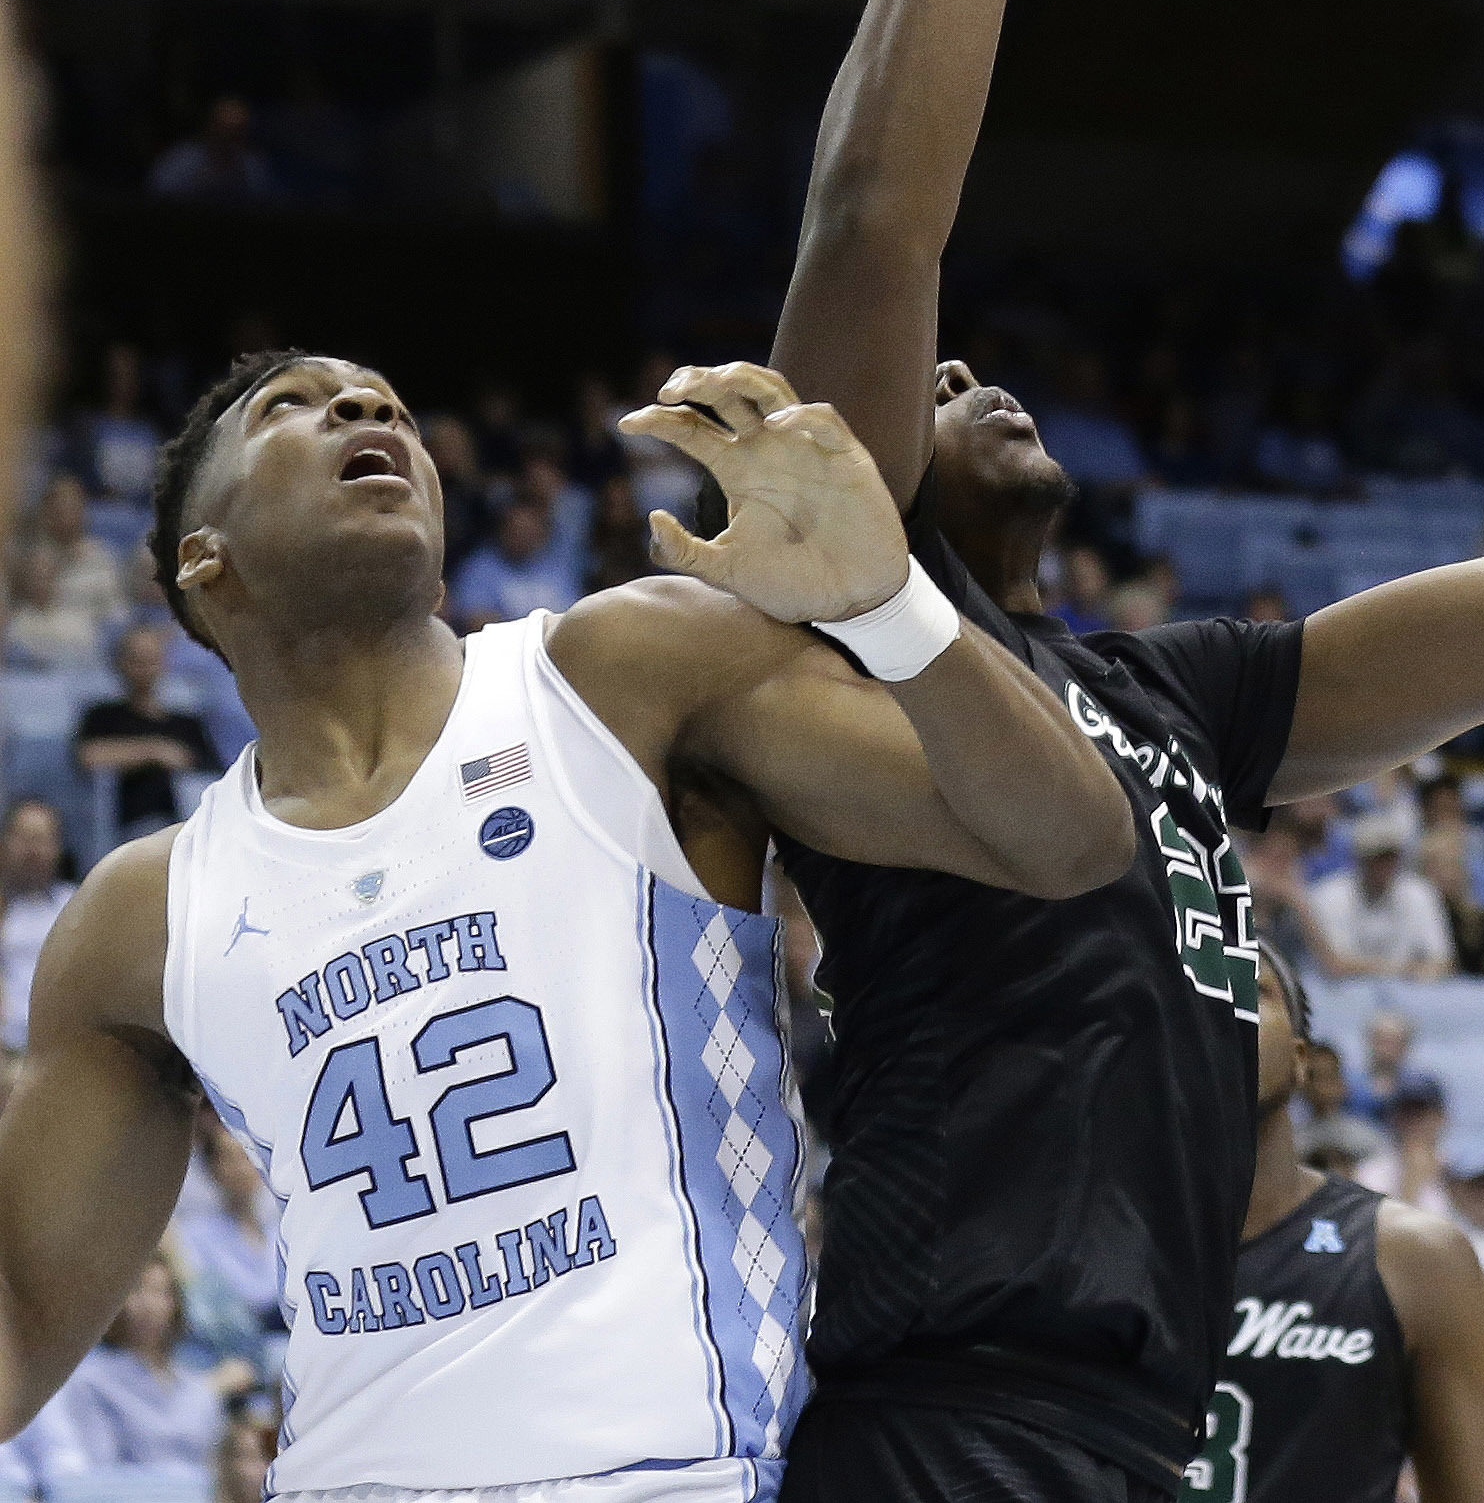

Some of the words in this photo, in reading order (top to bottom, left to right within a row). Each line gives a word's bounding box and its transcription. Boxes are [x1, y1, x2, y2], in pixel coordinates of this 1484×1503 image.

[275, 911, 507, 1059] NORTH
[299, 995, 577, 1230] 42
[304, 1195, 617, 1335] CAROLINA
[1226, 1297, 1375, 1365] Wave
